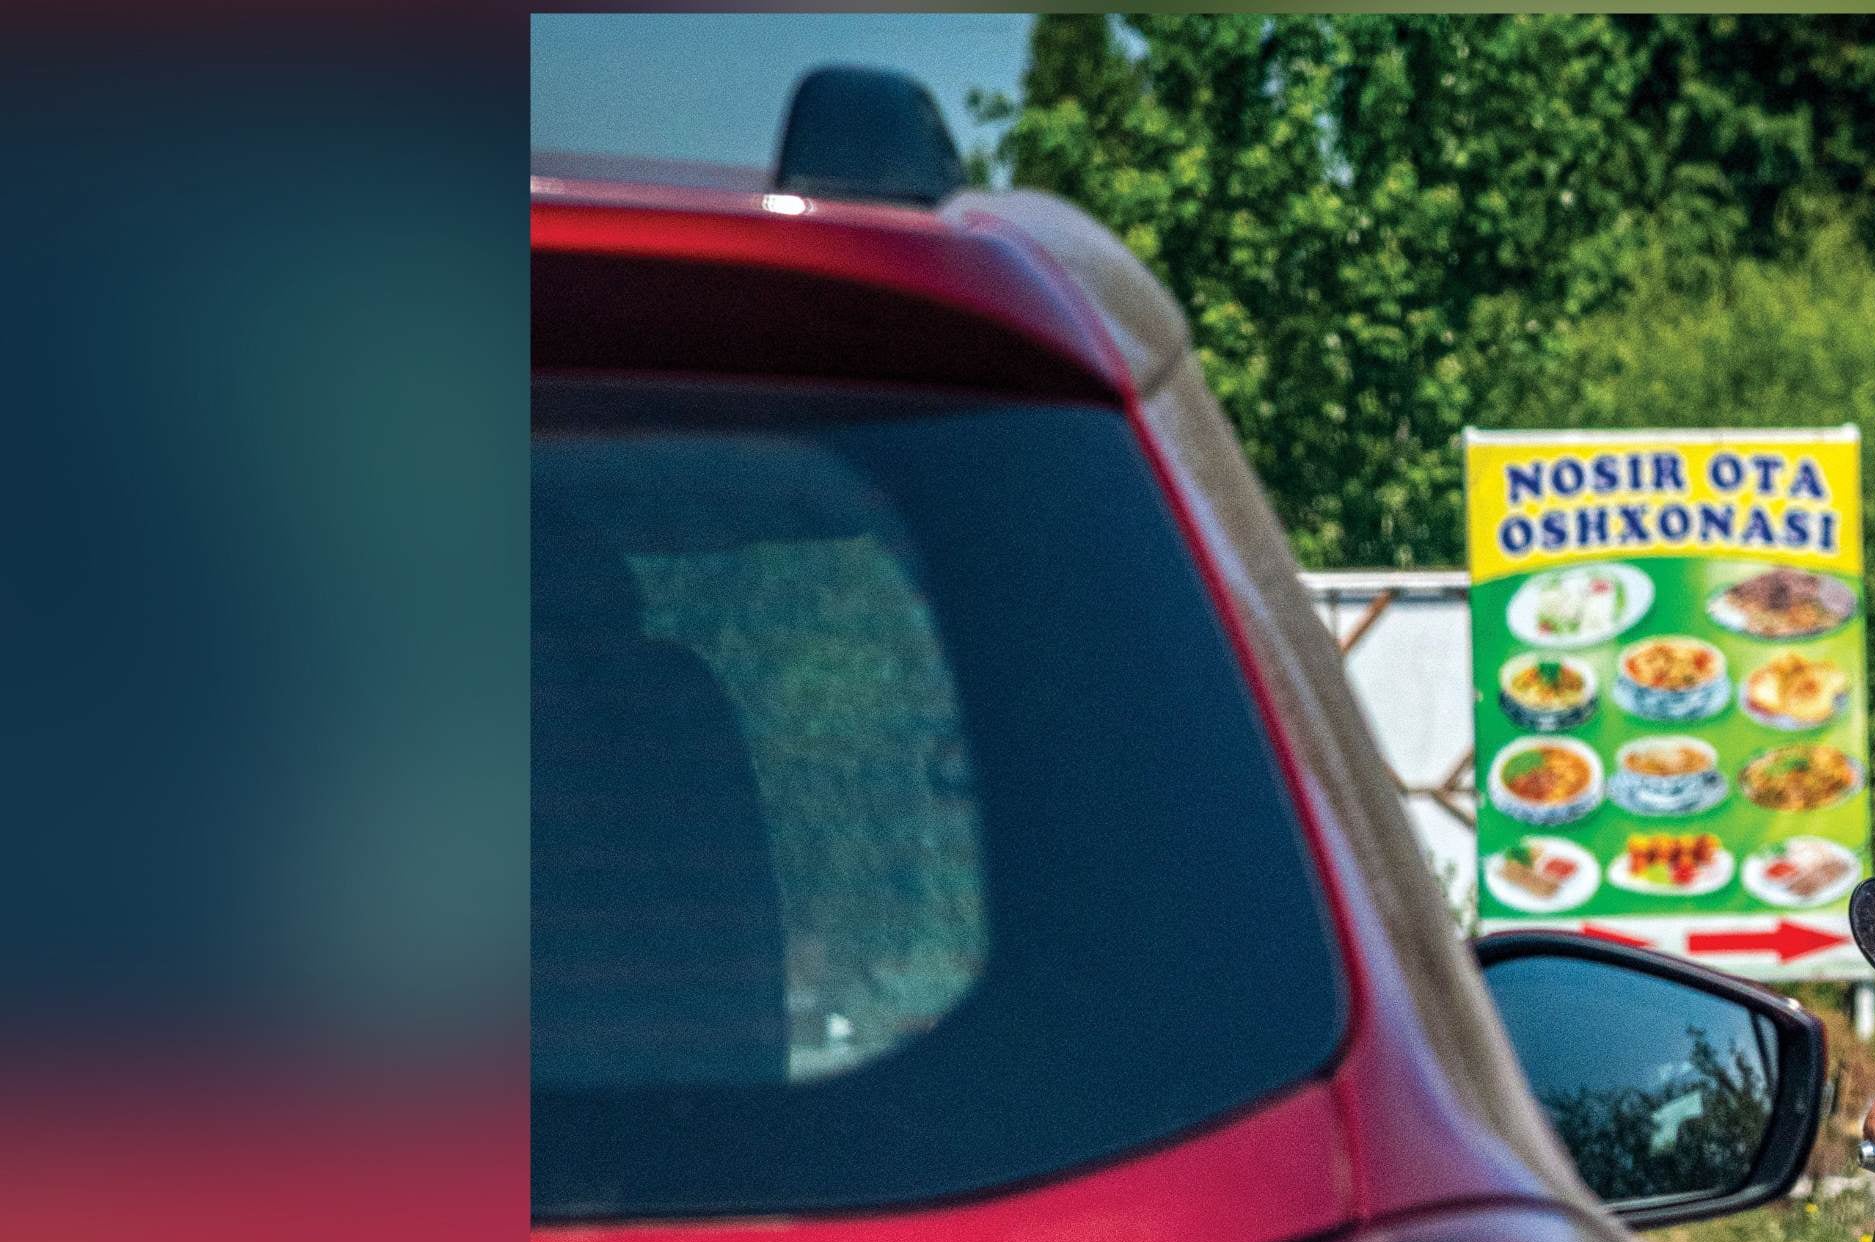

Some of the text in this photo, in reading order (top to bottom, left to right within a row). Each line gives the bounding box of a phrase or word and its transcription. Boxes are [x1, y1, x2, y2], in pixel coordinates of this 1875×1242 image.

[1506, 453, 1825, 503] NOSIR OTA
[1501, 503, 1835, 553] OSHXONASI
